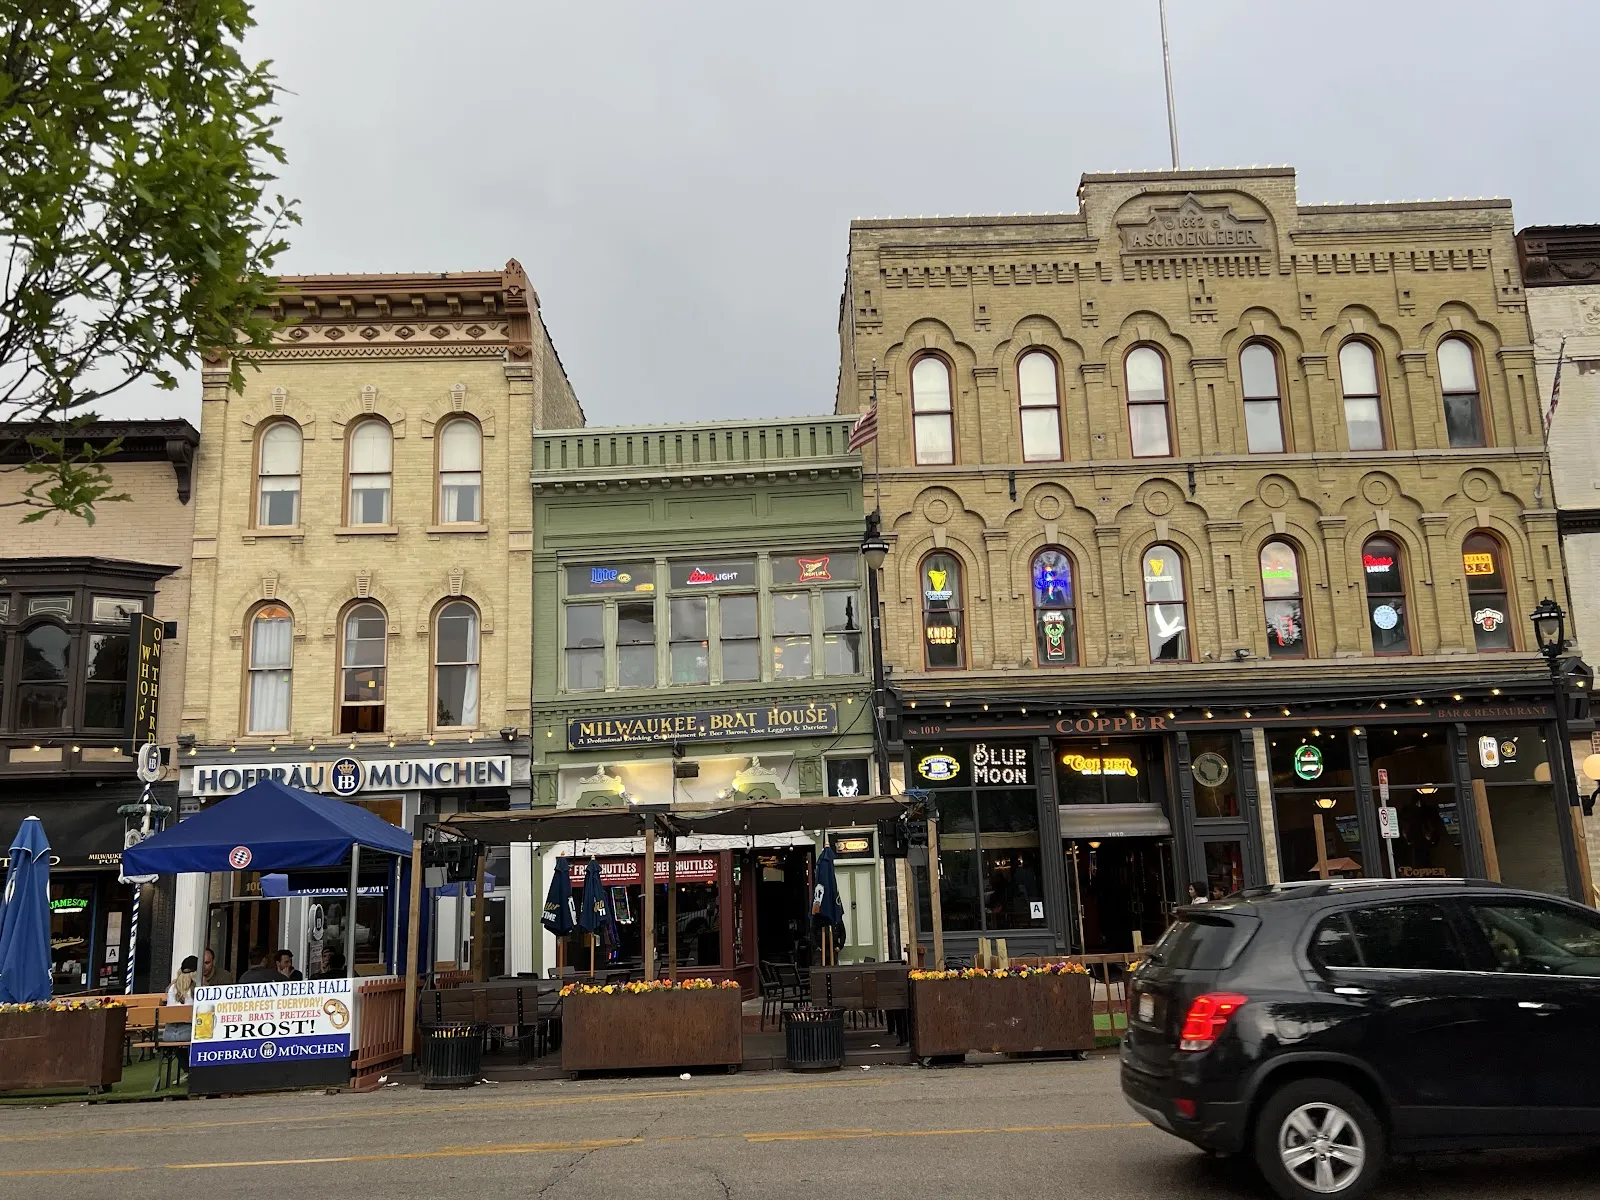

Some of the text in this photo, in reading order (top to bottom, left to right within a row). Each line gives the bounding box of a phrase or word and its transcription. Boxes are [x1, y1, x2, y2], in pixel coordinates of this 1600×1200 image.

[1177, 216, 1205, 229] 1882
[1363, 554, 1393, 567] Coors
[1366, 565, 1390, 573] LIGHT
[590, 567, 617, 584] Lite
[690, 570, 738, 583] Coors LIGHT
[1034, 577, 1066, 589] Corona
[139, 644, 151, 721] WHO'S
[148, 627, 161, 745] ON THIRD
[580, 708, 828, 738] MILWAUKEE BRAT HOUSE
[920, 726, 941, 735] 1019
[1055, 716, 1168, 734] COPPER
[1438, 709, 1460, 718] BAR
[1463, 708, 1471, 717] &
[1474, 706, 1548, 717] RESTAURANT
[587, 736, 622, 745] Professional
[767, 726, 792, 734] Leggers
[973, 743, 1027, 766] BLUE
[1483, 741, 1495, 751] Lite
[974, 765, 1027, 784] MOON
[1062, 755, 1139, 777] COPPER
[338, 775, 356, 790] HB
[369, 760, 506, 787] MÜNCHEN
[1398, 866, 1447, 877] COPPER
[50, 898, 89, 910] JAMESON
[1033, 904, 1041, 913] A
[109, 948, 116, 957] A
[196, 979, 351, 1002] OLD GERMAN BEER HALL
[216, 996, 324, 1013] OKTOBERFEST EVERYDAY!
[220, 1009, 321, 1023] BEER BRATS PRETZELS
[223, 1019, 316, 1039] PROST!
[197, 1048, 257, 1062] HOFBRÄU
[278, 1043, 345, 1057] MÜNCHEN
